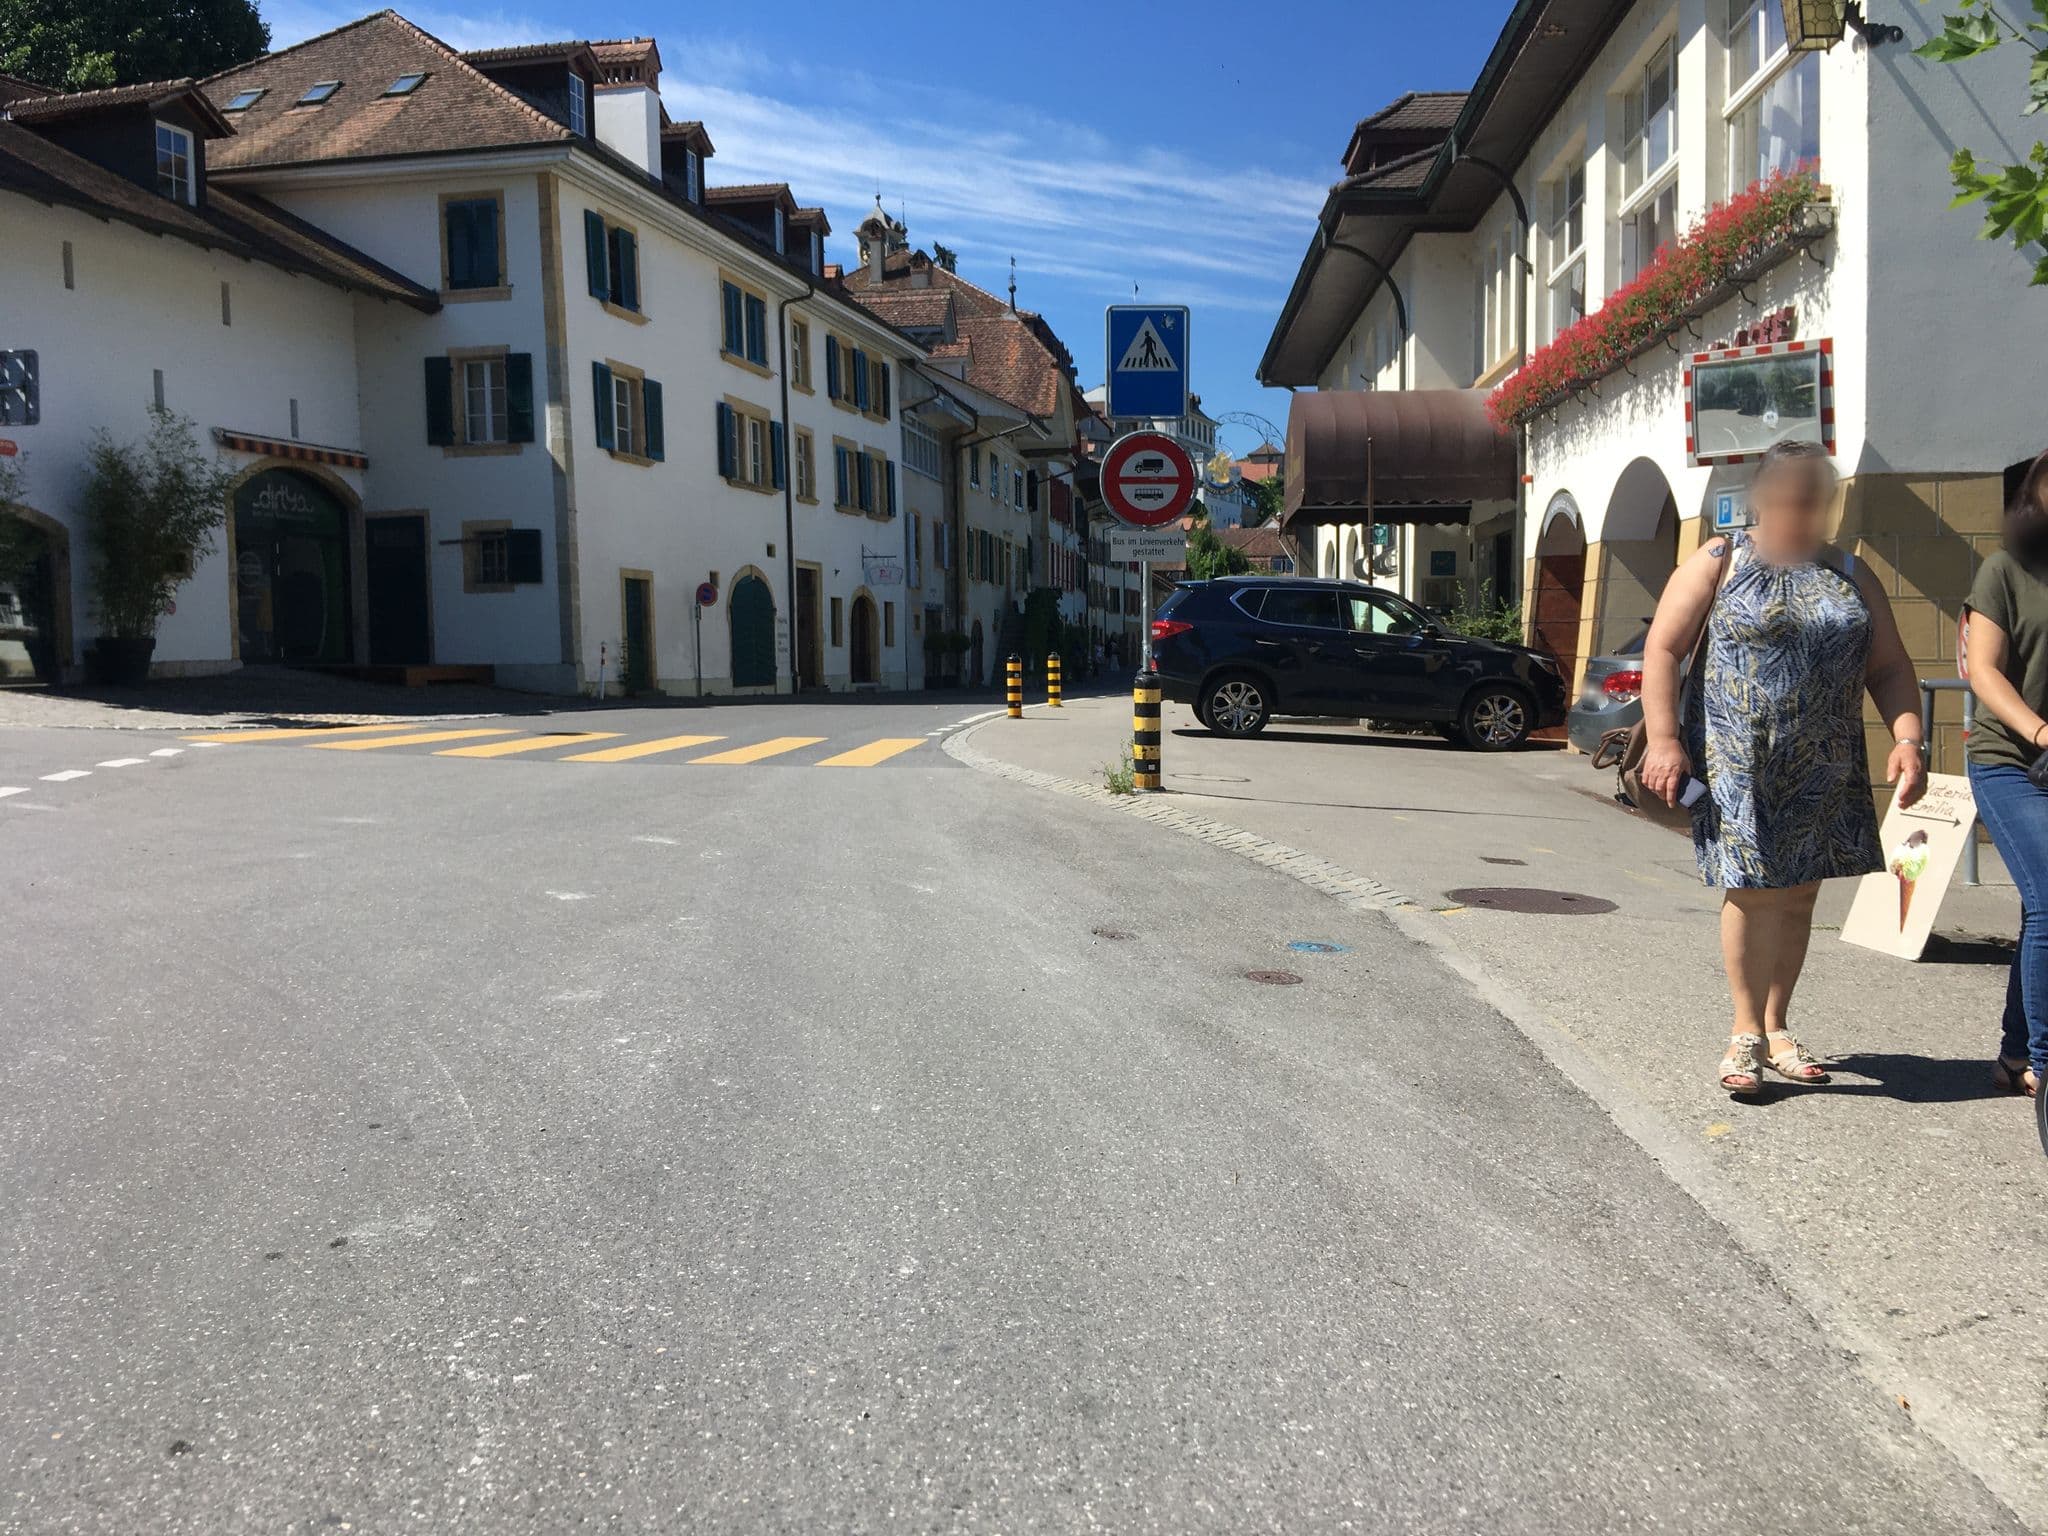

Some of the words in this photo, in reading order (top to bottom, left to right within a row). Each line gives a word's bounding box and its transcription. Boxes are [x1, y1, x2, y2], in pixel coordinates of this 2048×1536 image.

[1112, 537, 1125, 546] Bus
[1128, 537, 1137, 546] im
[1139, 536, 1185, 546] Linienverkehr
[1132, 546, 1166, 557] gestattet
[1928, 781, 1973, 802] lateria
